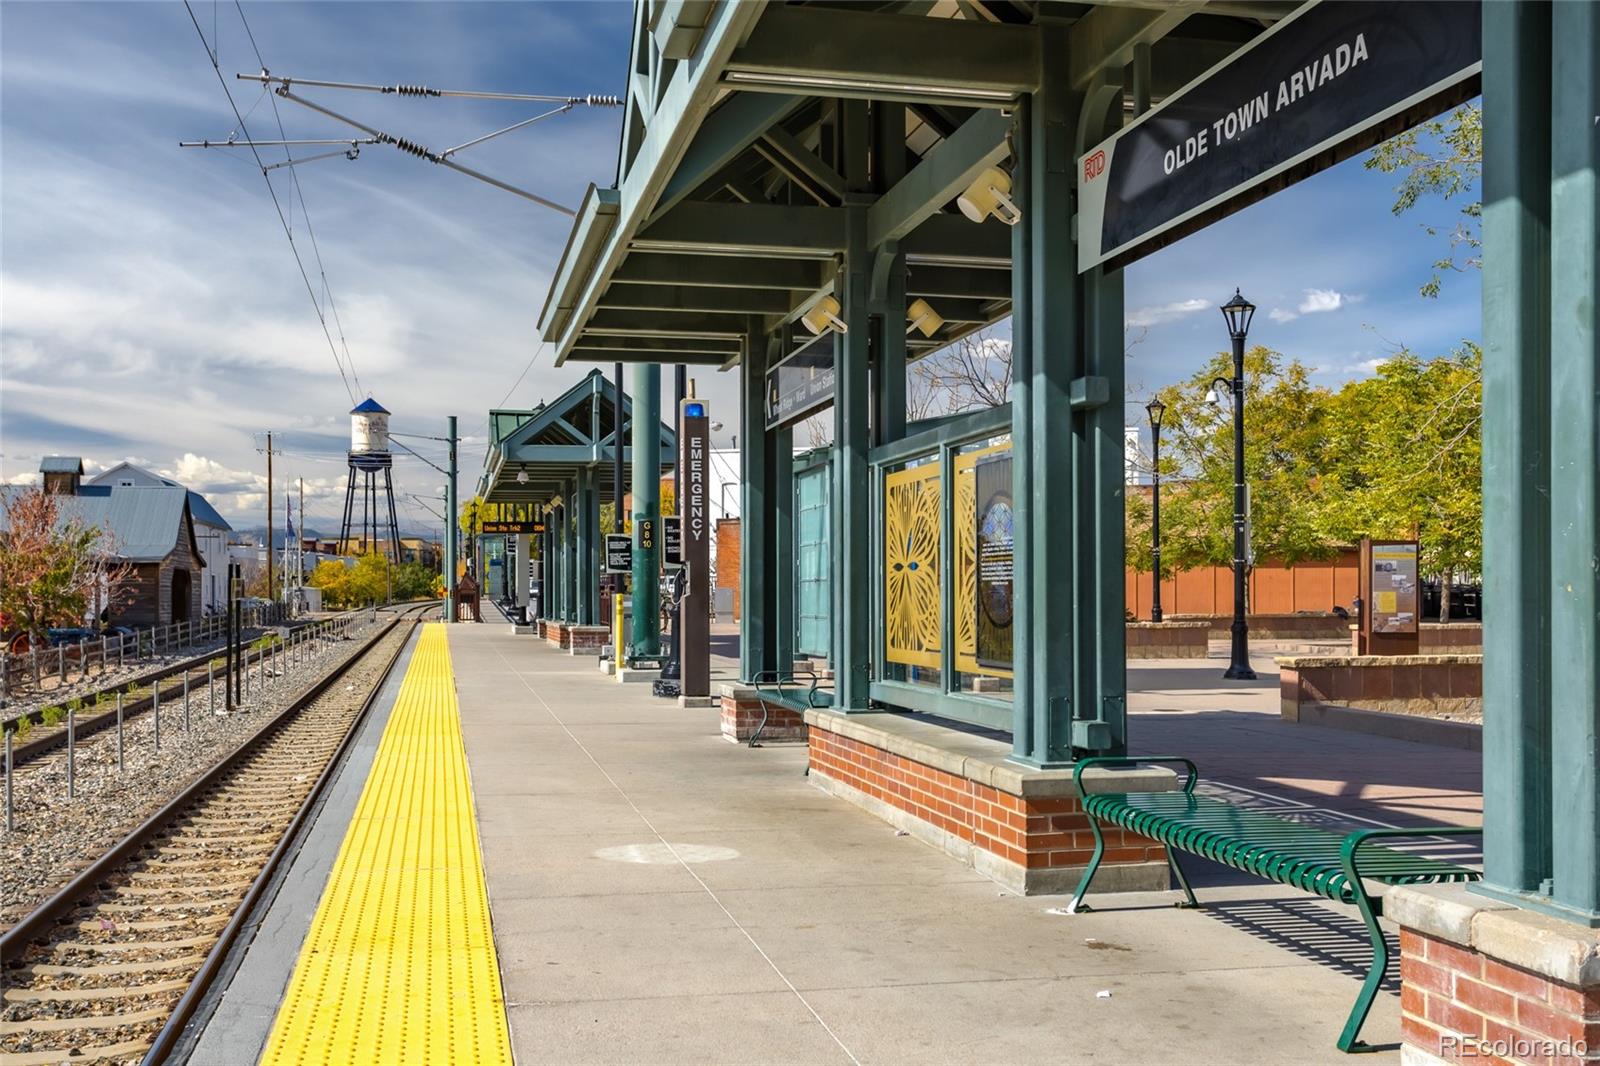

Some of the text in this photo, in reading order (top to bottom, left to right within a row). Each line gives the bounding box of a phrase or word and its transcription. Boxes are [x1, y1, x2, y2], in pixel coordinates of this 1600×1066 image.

[1163, 32, 1369, 176] OLDE TOWN ARVADA
[1083, 149, 1106, 184] RTD
[690, 437, 703, 541] EMERGENCY
[643, 521, 651, 530] G
[642, 540, 652, 548] 10
